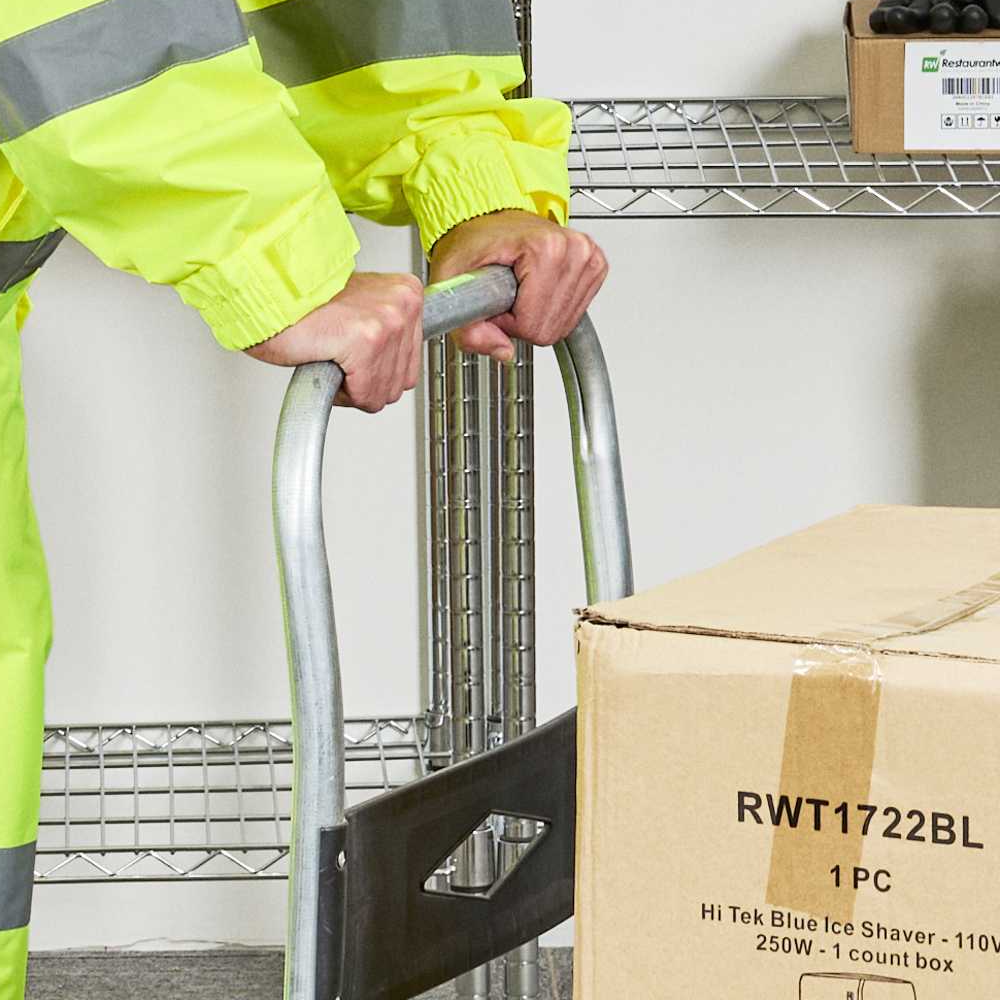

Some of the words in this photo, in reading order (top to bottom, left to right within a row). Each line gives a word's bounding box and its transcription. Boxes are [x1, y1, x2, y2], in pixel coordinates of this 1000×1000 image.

[737, 791, 984, 849] RWT1722BL
[830, 864, 840, 888] 1
[853, 867, 892, 893] PC
[701, 903, 722, 921] Hi
[728, 905, 764, 926] Tek
[771, 910, 818, 932] Blue
[825, 916, 855, 936] Ice
[861, 921, 936, 945] Shaver
[756, 934, 812, 956] 250W
[832, 942, 841, 959] 1
[849, 947, 910, 968] count
[916, 950, 954, 972] box
